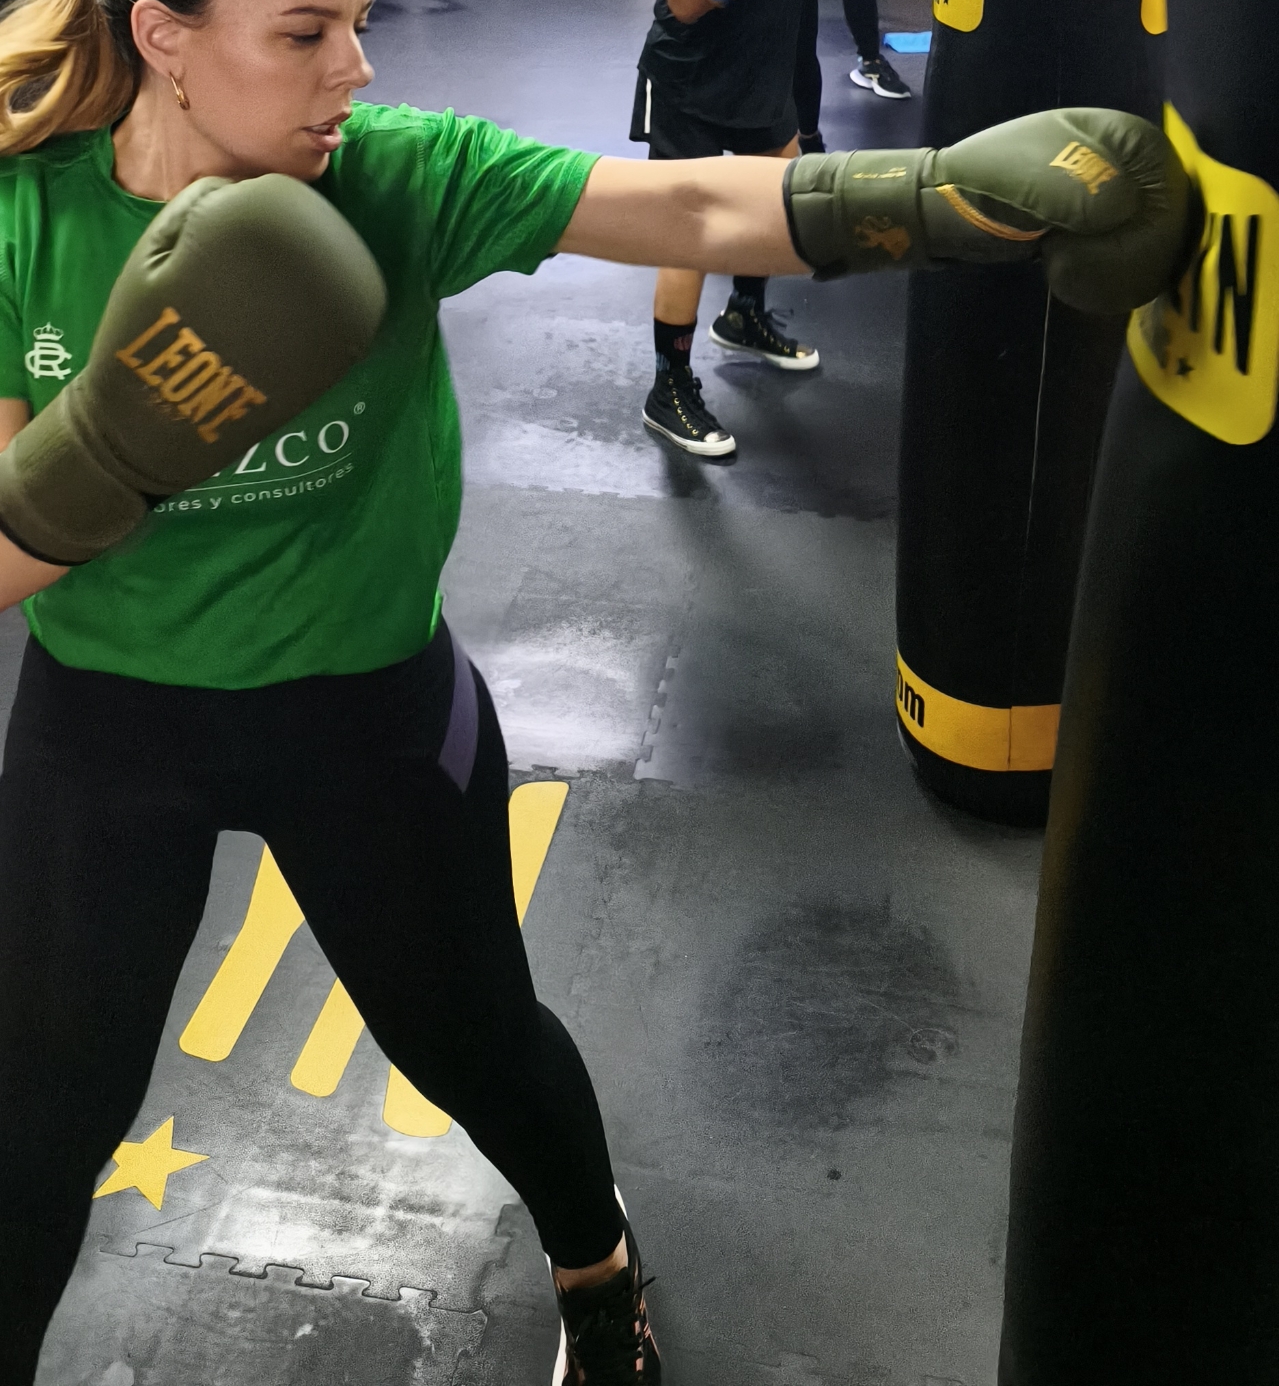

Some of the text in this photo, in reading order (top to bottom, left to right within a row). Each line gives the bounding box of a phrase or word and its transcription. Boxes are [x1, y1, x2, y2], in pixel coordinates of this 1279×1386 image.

[115, 306, 268, 444] LEONE
[210, 496, 223, 510] y
[231, 462, 354, 504] consultores
